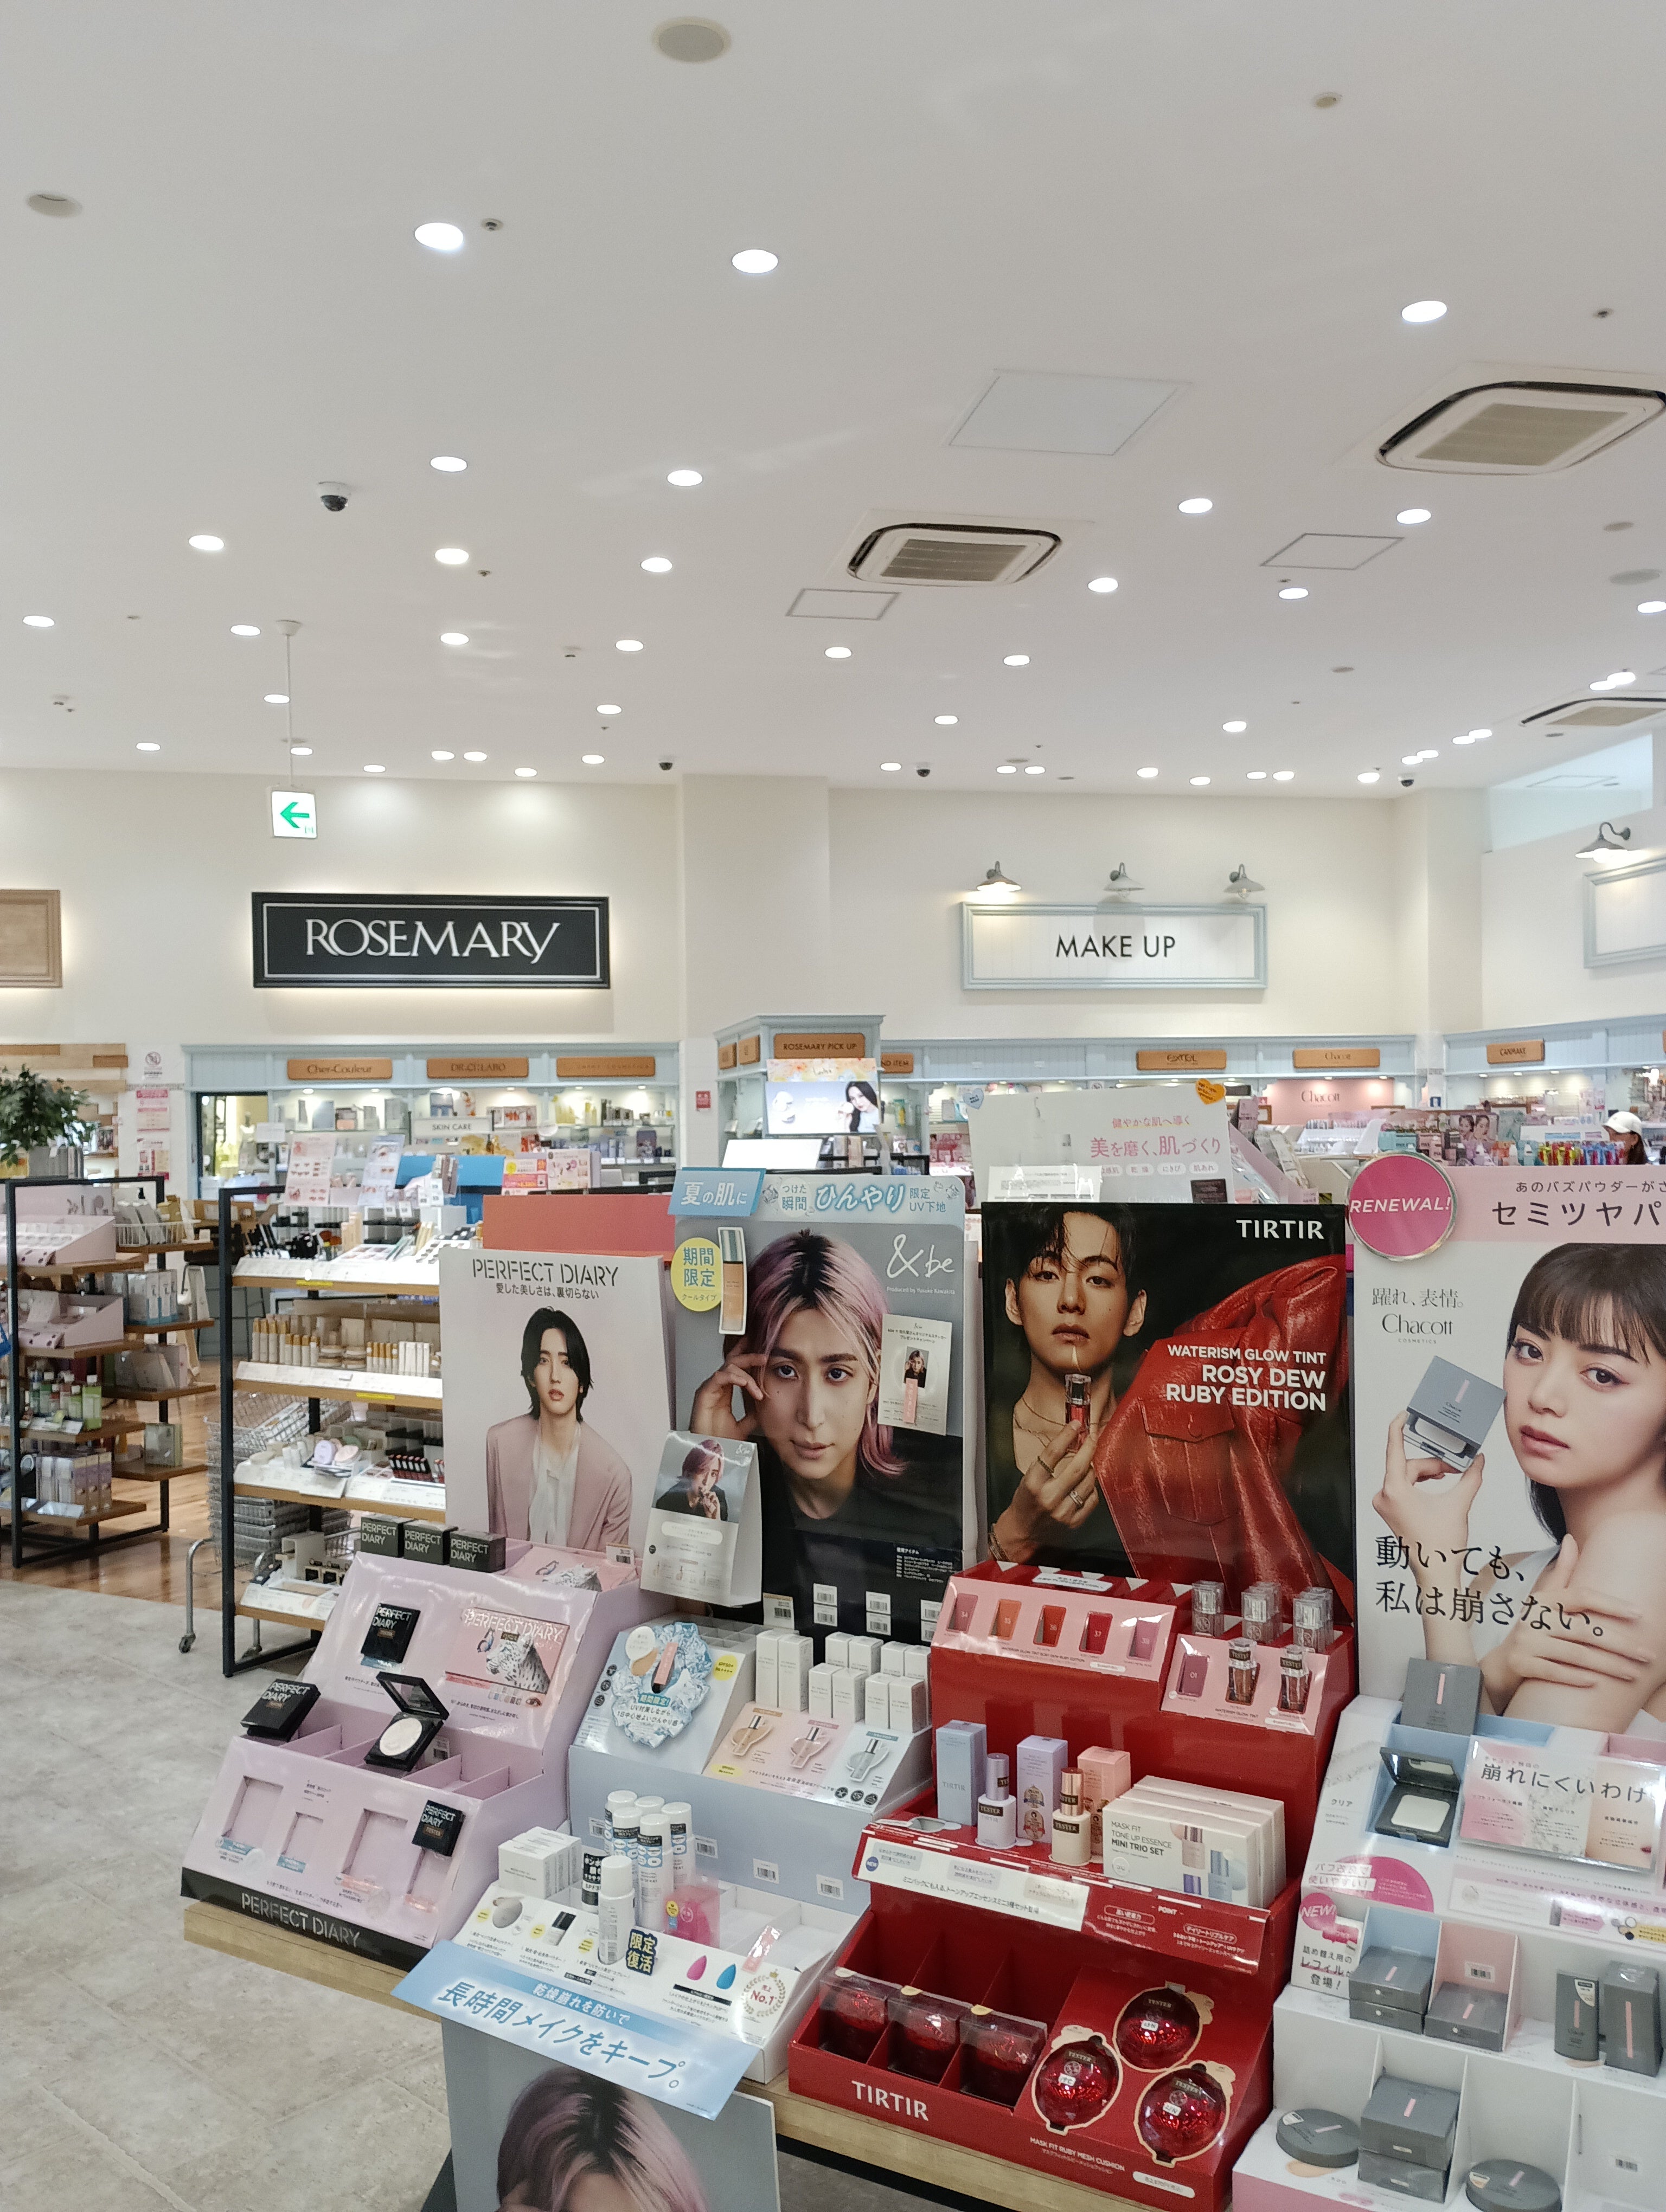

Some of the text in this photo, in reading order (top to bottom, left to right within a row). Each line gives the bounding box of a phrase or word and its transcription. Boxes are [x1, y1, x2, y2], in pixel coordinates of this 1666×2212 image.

[305, 918, 560, 964] ROSEMARY
[1056, 935, 1175, 957] MAKE UP
[1112, 1116, 1190, 1128] 健やかな肌へ導く
[1091, 1136, 1221, 1158] 美を磨く、肌づくり
[681, 1181, 747, 1206] 夏の肌に
[782, 1185, 806, 1194] つけた
[816, 1184, 906, 1212] ひんやり
[909, 1188, 930, 1200] 限定
[782, 1197, 807, 1211] 瞬間
[909, 1201, 946, 1213] UV下地
[1350, 1197, 1452, 1214] RENEWAL!
[1492, 1201, 1662, 1226] セミツヤパ
[1236, 1219, 1324, 1239] TIRTIR
[683, 1247, 714, 1266] 期間
[887, 1234, 955, 1279] &be
[472, 1258, 619, 1287] PERFECT DIARY
[684, 1269, 715, 1288] 限定
[496, 1283, 599, 1300] 愛した美しさは、裏切らない
[1382, 1313, 1453, 1335] Chacott
[1168, 1344, 1327, 1365] WATERISM GLOW TINT
[1202, 1364, 1327, 1389] ROSY DEW
[1167, 1383, 1327, 1411] RUBY EDITION
[362, 1522, 396, 1536] PERFECT
[405, 1529, 442, 1545] PERFECT
[362, 1532, 386, 1545] DIARY
[405, 1540, 430, 1554] DIARY
[451, 1539, 489, 1554] PERFECT
[451, 1549, 477, 1563] DIARY
[1375, 1535, 1525, 1582] 動いても、
[377, 1606, 412, 1621] PERFECT
[1375, 1580, 1604, 1637] 私は崩さない。
[371, 1616, 398, 1629] DIARY
[262, 1690, 291, 1703] DIARY
[268, 1682, 310, 1696] PERFECT
[1481, 1763, 1646, 1803] 崩れにくいわけ
[425, 1805, 456, 1822] PERFECT
[979, 1805, 1002, 1815] TESTER
[422, 1813, 443, 1828] DIARY
[1055, 1821, 1078, 1832] TESTER
[1112, 1821, 1141, 1832] MASK FIT
[1112, 1830, 1172, 1849] TONE UP ESSENCE
[1112, 1838, 1164, 1856] MINI TRIO SET
[1158, 1906, 1177, 1915] POINT
[1302, 1904, 1337, 1918] NEW!
[241, 1893, 308, 1931] PERFECT
[312, 1917, 362, 1949] DIARY
[630, 1931, 657, 1955] 限定
[627, 1951, 653, 1974] 復活
[532, 1982, 632, 2027] 乾燥崩れを防いで
[750, 1990, 774, 2006] No.1
[438, 1980, 687, 2090] 長時間メイクをキープ。
[852, 2081, 930, 2122] TIRTIR
[1030, 2137, 1125, 2172] MASK FIT RUBY MESH CUSHION
